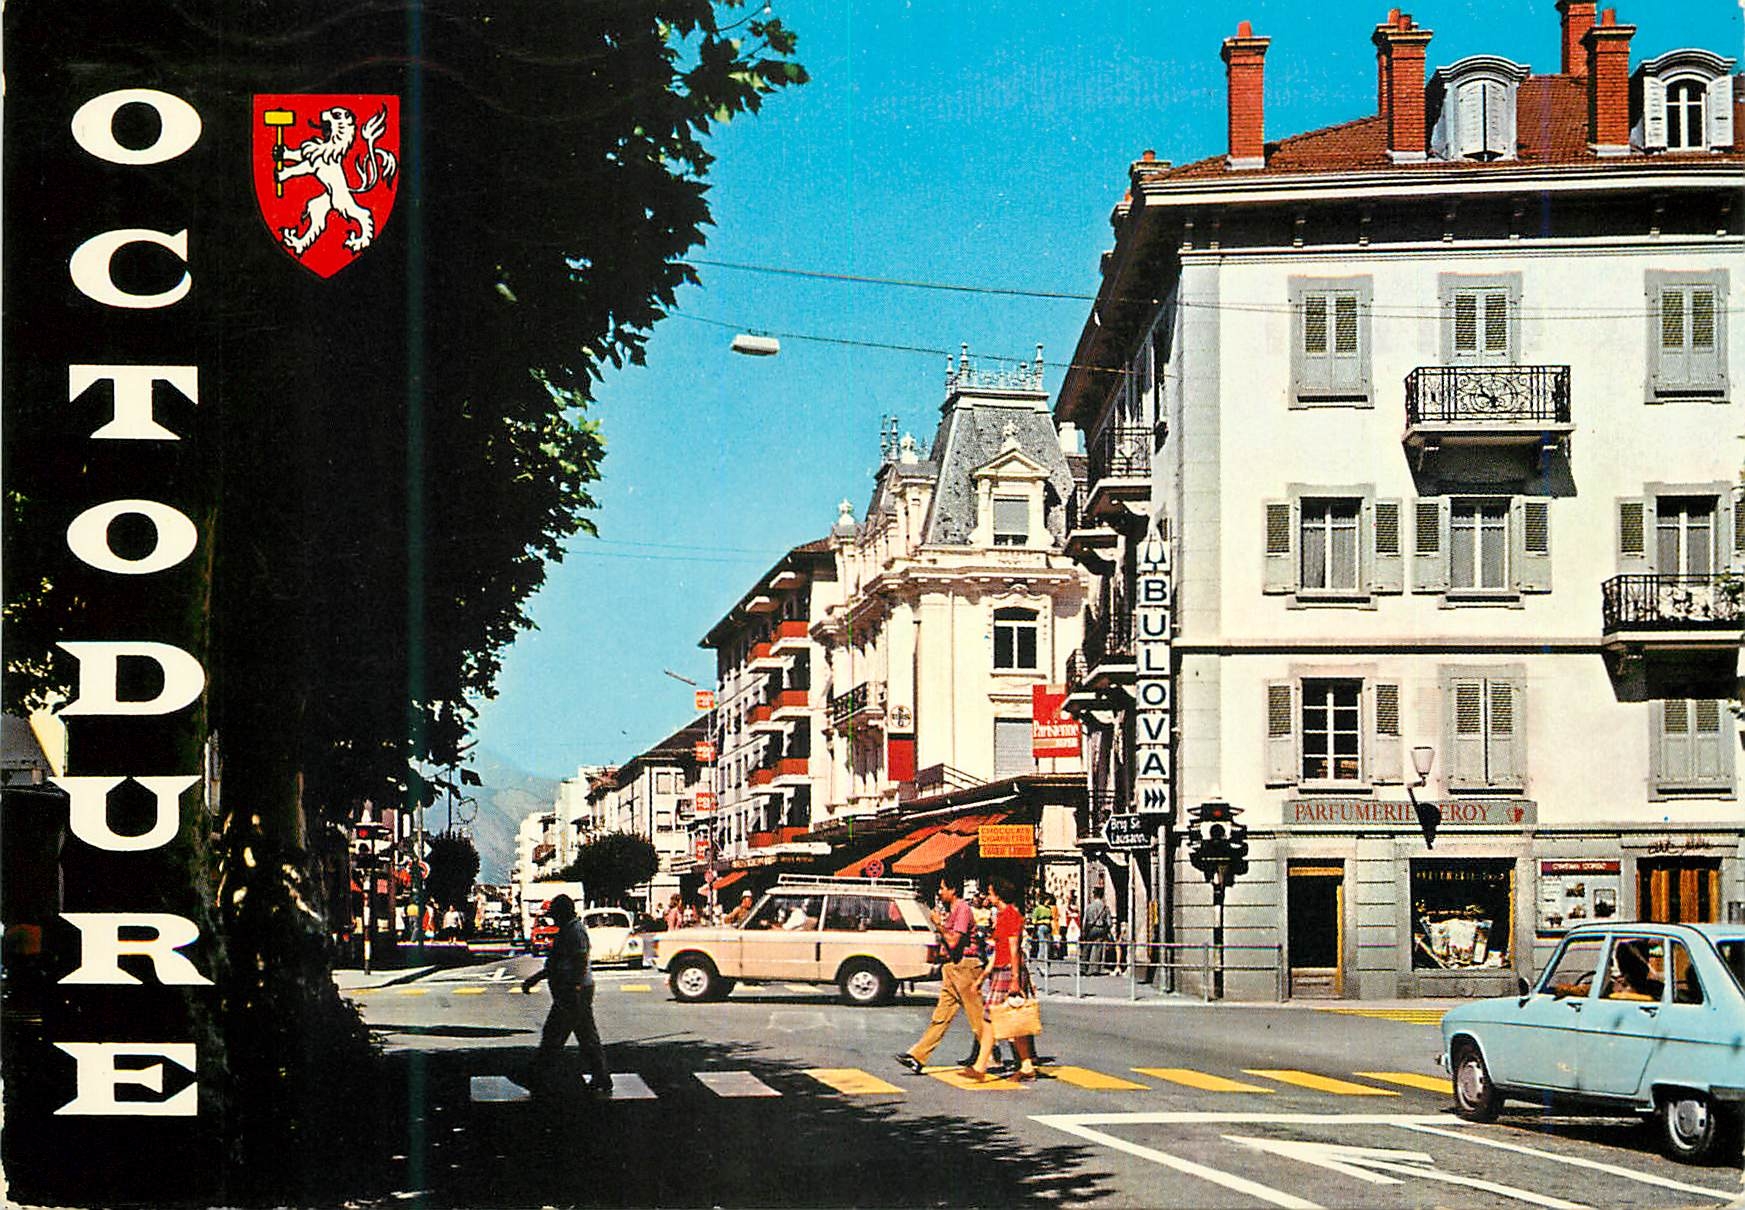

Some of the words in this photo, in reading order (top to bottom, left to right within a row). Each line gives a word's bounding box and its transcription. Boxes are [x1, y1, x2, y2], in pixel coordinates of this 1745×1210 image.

[1142, 579, 1168, 776] BULOVA
[1295, 803, 1416, 821] PARFUMERIE
[1434, 803, 1491, 821] EROY
